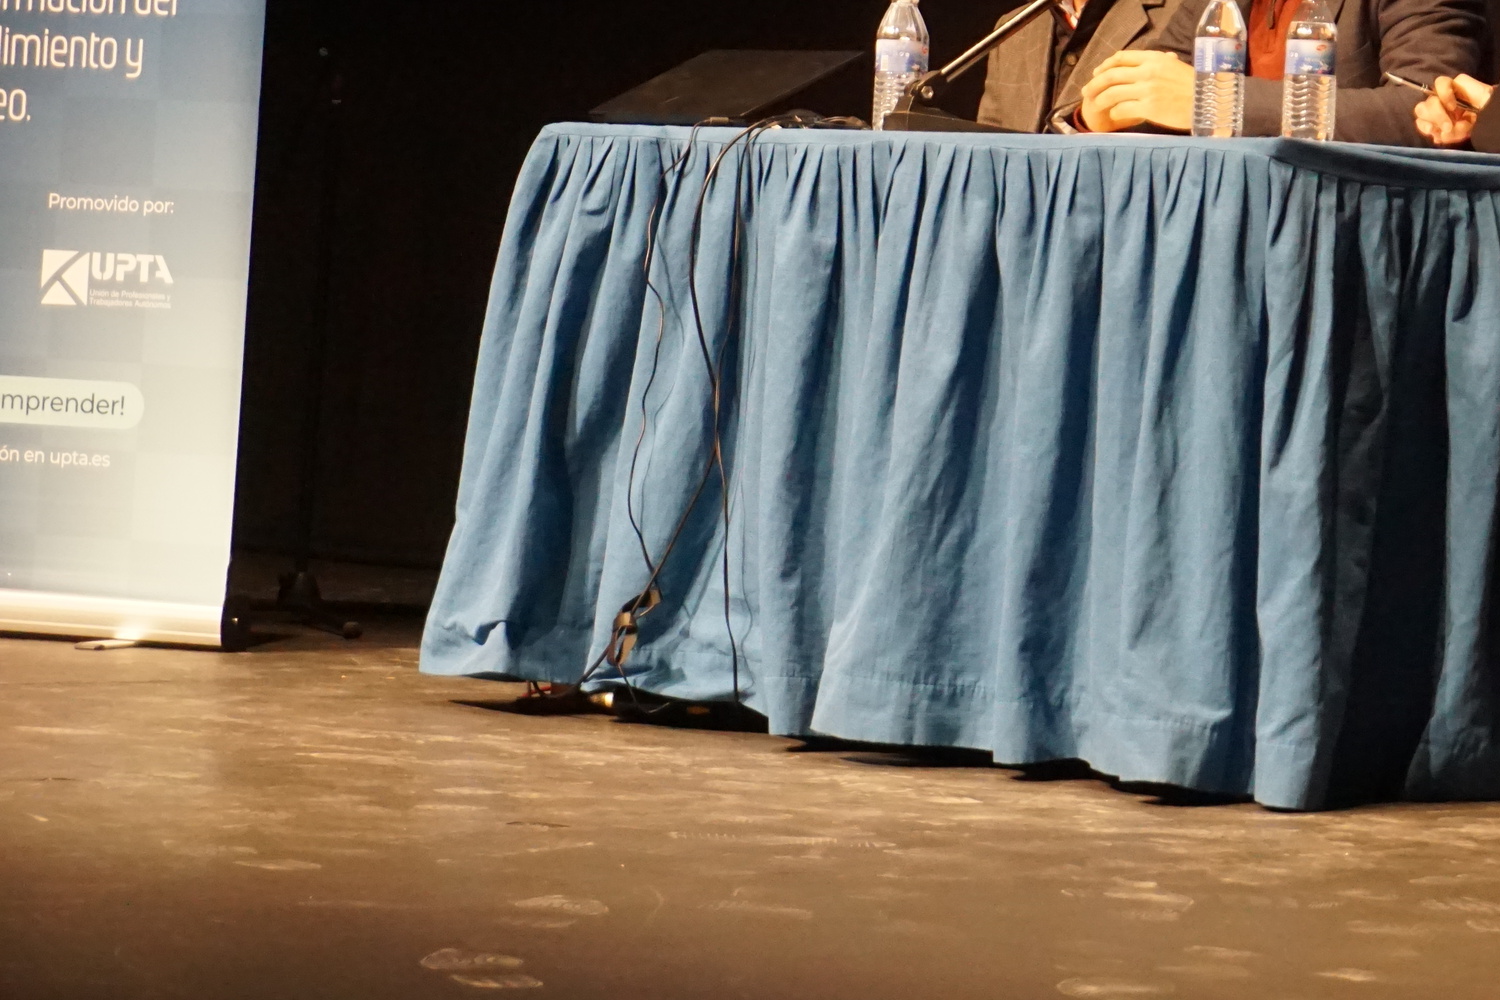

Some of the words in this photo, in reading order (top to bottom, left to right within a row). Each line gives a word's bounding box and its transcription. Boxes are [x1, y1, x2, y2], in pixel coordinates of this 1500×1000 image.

[0, 25, 118, 69] imiento
[125, 37, 144, 79] y
[48, 192, 139, 213] Promovido
[143, 198, 175, 217] por:
[91, 251, 174, 284] UPTA
[24, 449, 45, 464] en
[49, 450, 111, 469] upta.es
